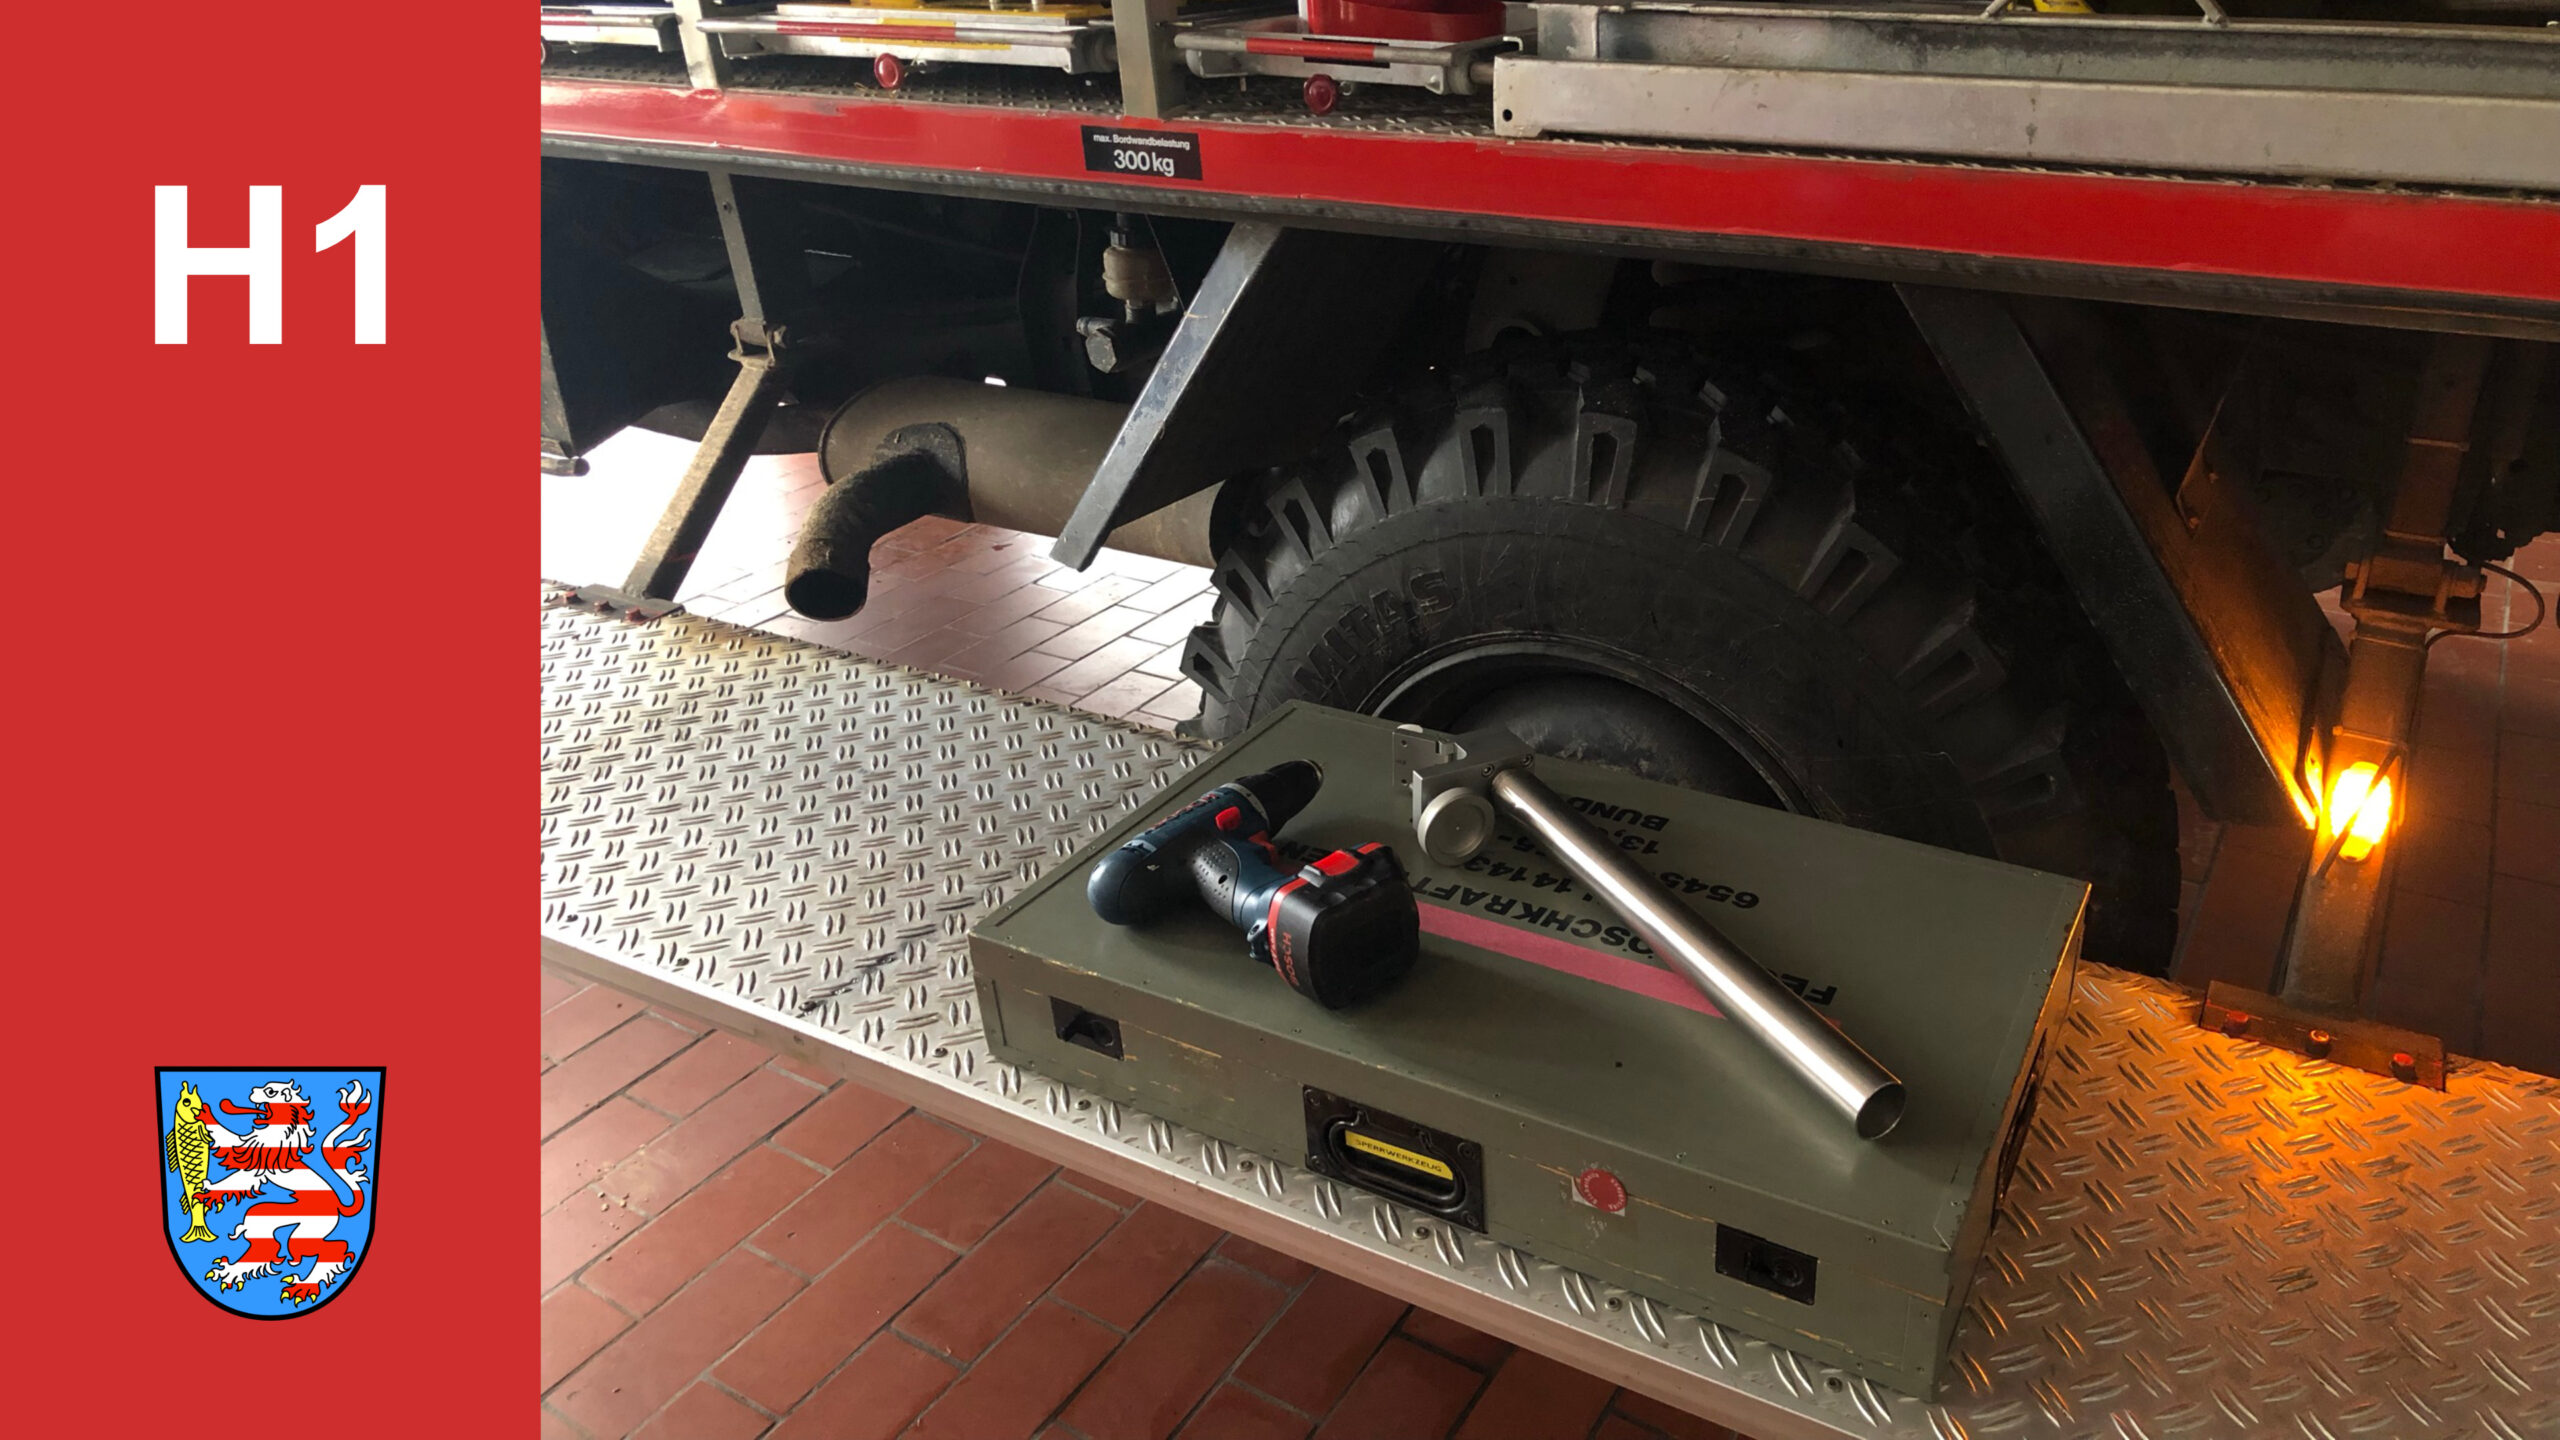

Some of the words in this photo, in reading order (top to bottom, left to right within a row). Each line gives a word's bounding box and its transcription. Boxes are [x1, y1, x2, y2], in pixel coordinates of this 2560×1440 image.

[1093, 133, 1112, 143] max.
[1112, 134, 1191, 151] Bordwandbelastung
[1113, 149, 1151, 171] 300
[1151, 152, 1175, 177] kg
[1355, 1139, 1443, 1173] SPERRWERKZEUG
